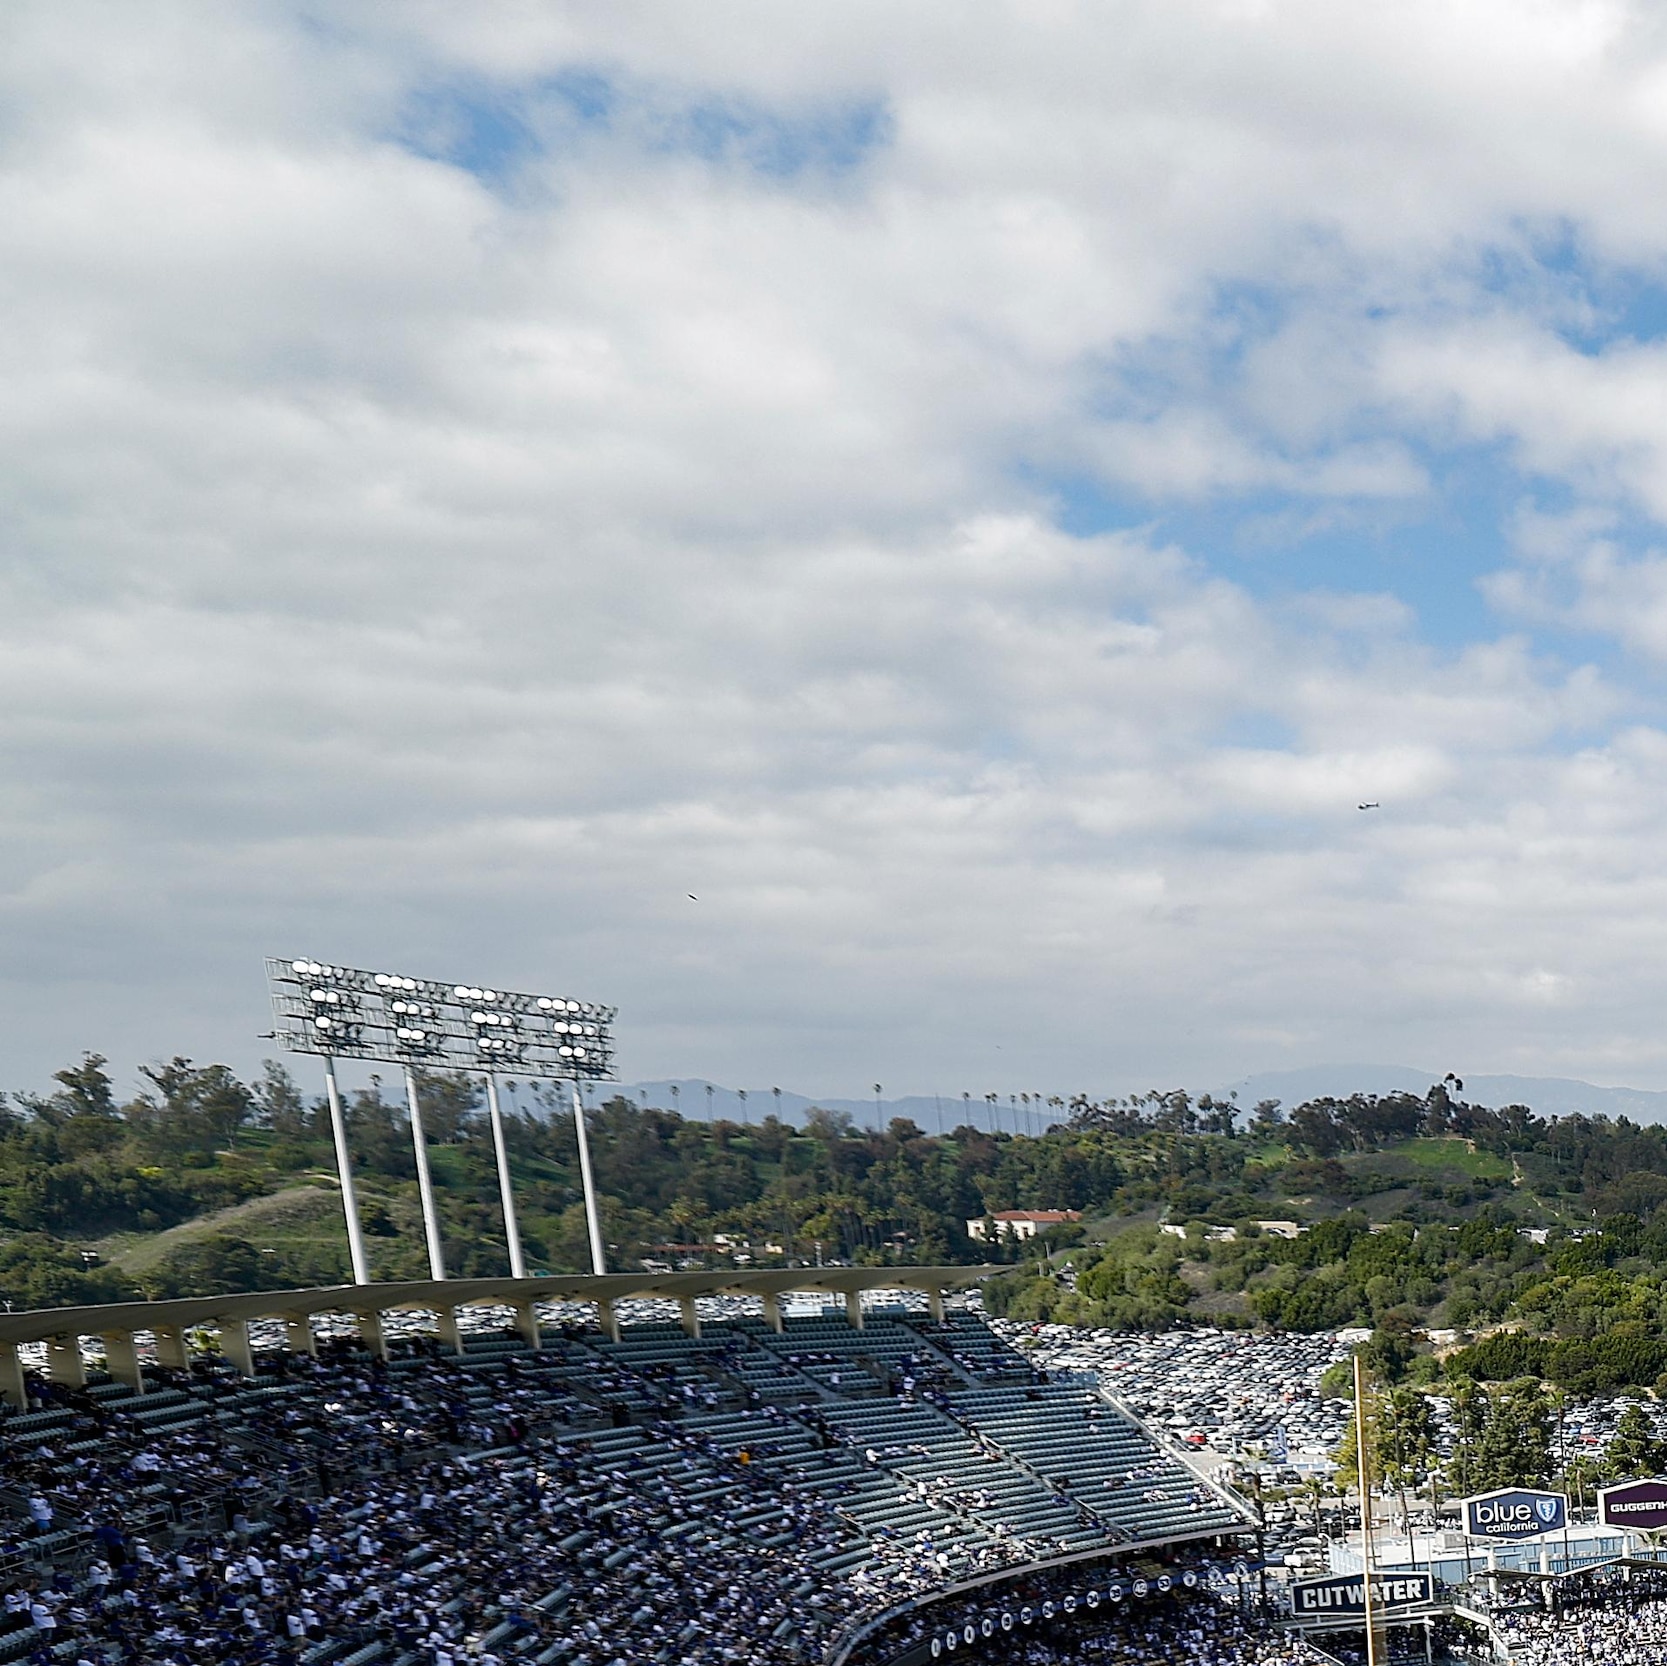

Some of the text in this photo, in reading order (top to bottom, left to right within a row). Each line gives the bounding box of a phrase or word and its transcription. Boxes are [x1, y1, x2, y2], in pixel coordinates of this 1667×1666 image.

[1476, 1501, 1532, 1524] blue
[1485, 1520, 1539, 1534] california
[1302, 1578, 1423, 1609] CUTWATER
